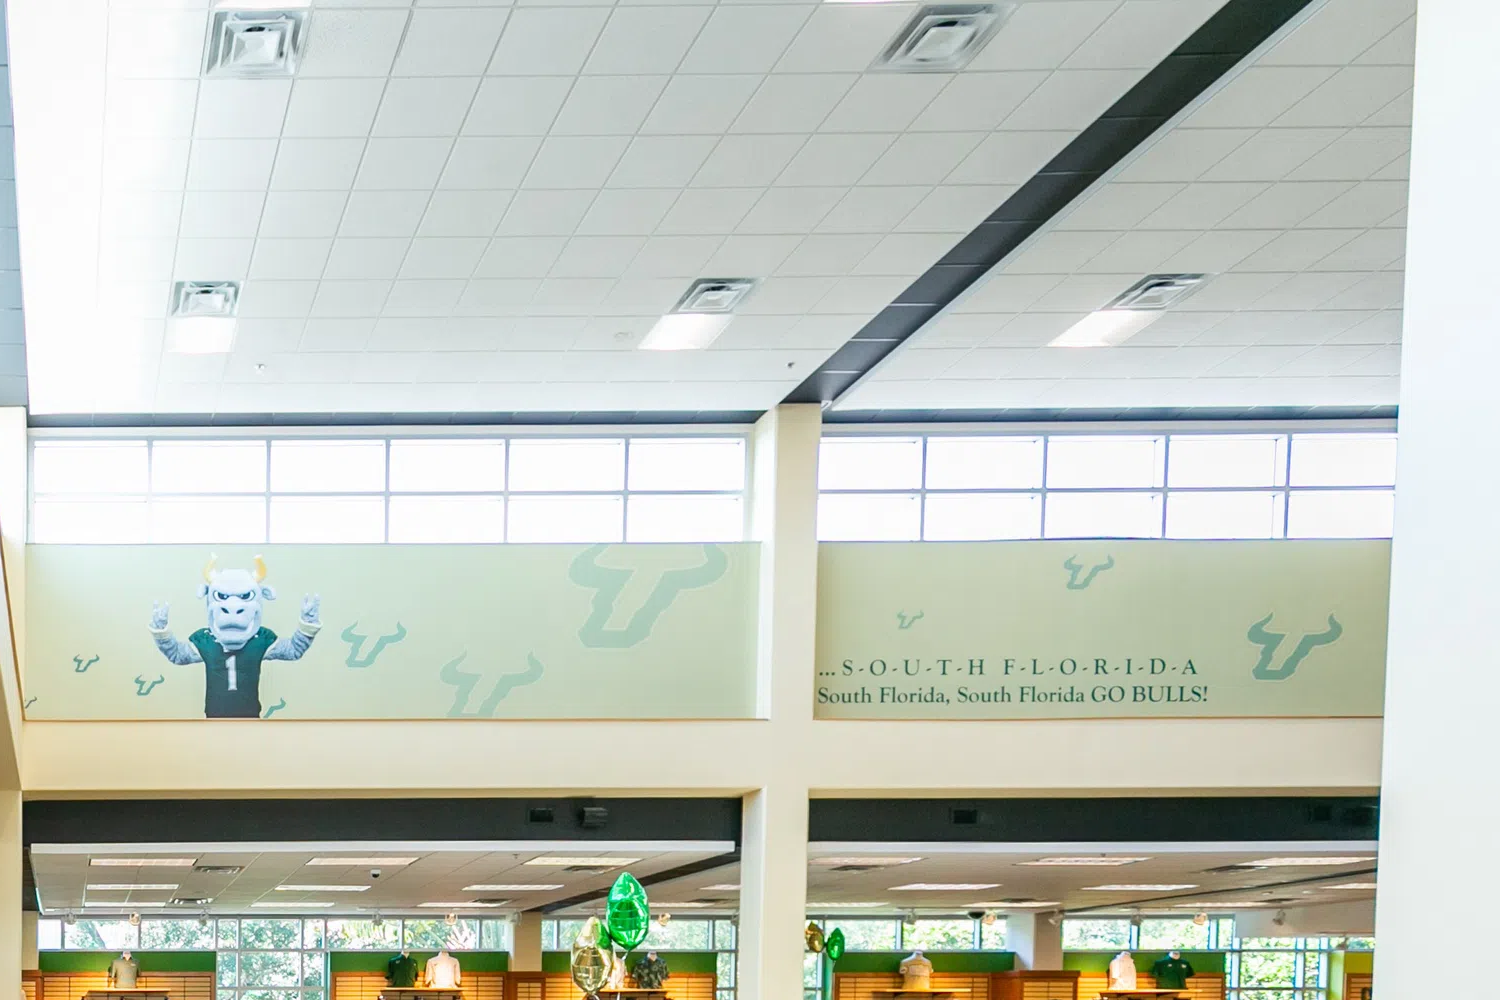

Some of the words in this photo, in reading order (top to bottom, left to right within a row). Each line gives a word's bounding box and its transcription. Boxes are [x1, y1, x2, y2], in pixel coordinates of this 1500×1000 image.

[225, 655, 237, 690] 1
[818, 687, 873, 704] South
[879, 686, 951, 705] Florida,
[957, 686, 1012, 704] South
[1018, 686, 1085, 703] Florida
[1091, 686, 1125, 703] GO
[1132, 685, 1208, 703] BULLS!
